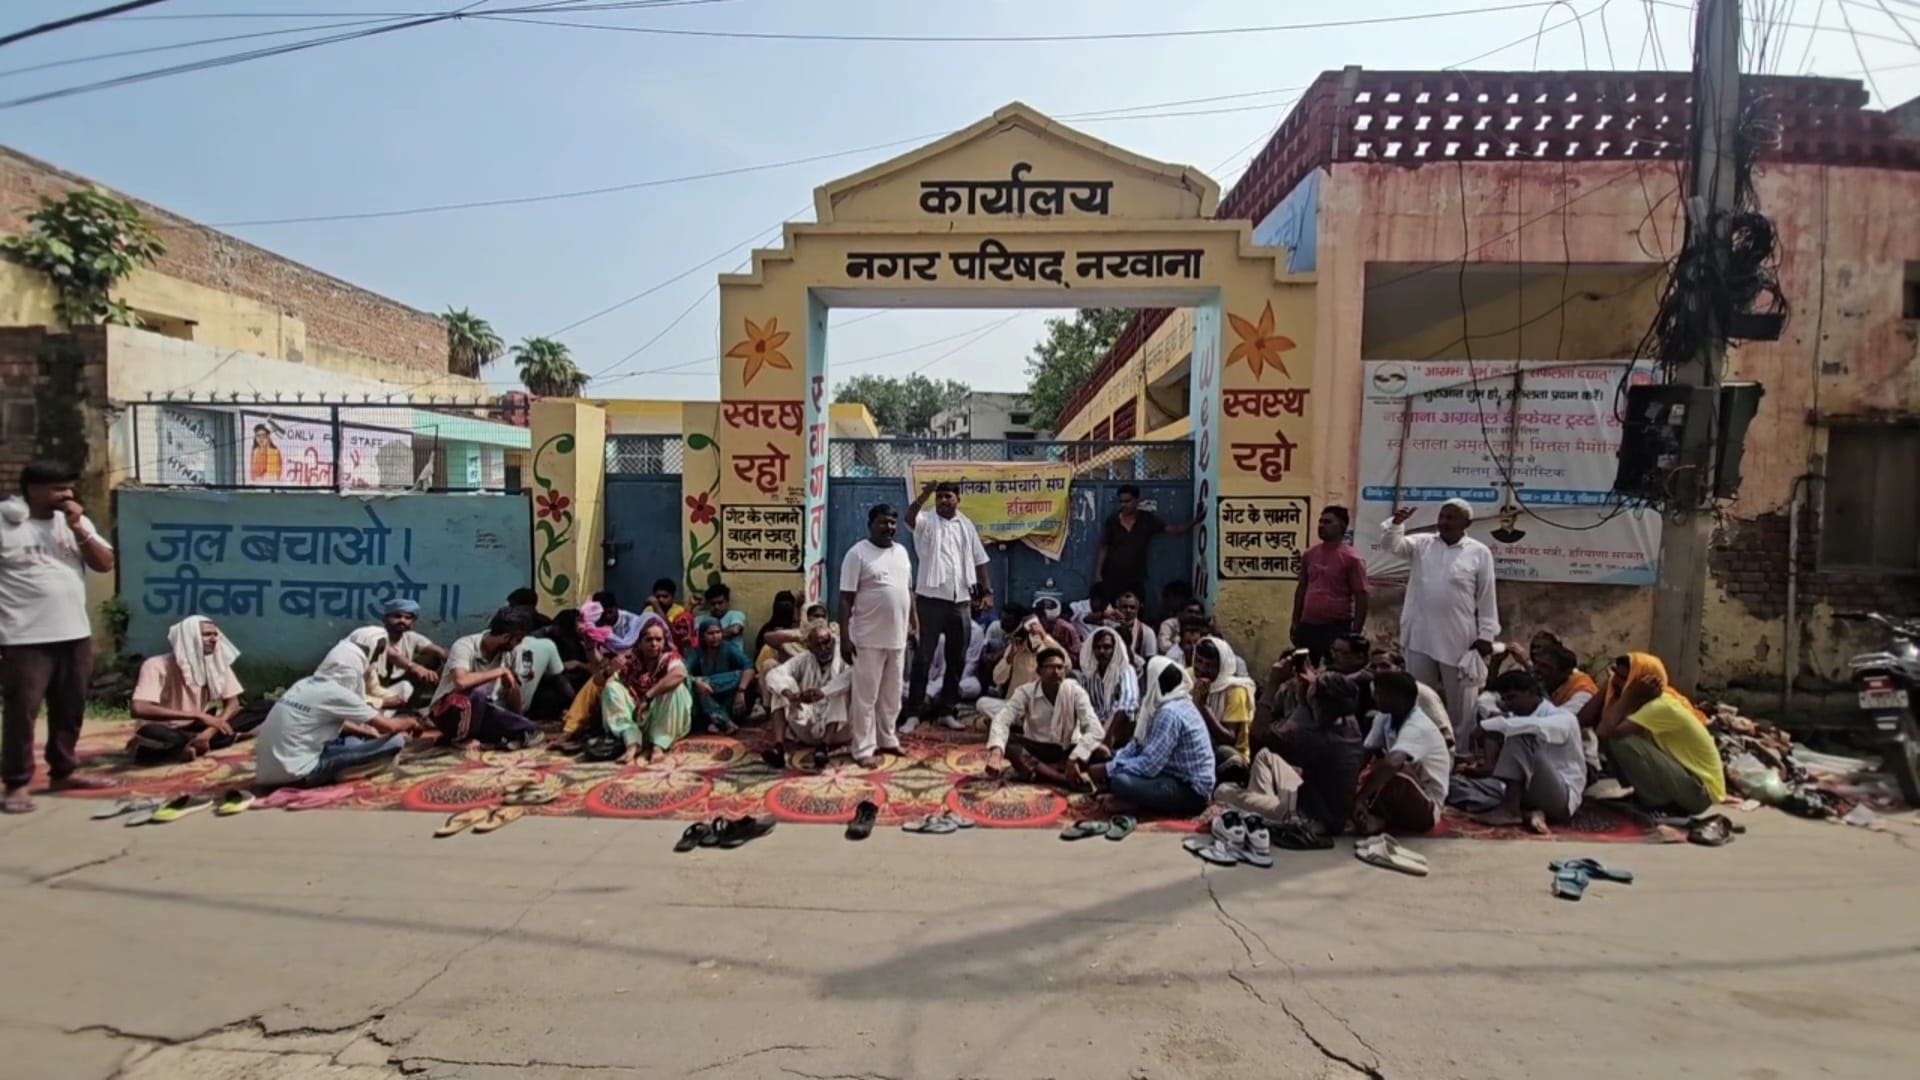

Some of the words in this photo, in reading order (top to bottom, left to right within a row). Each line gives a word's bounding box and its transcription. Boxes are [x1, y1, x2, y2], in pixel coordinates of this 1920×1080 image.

[919, 162, 1113, 215] कार्यालय
[846, 252, 941, 280] नगर
[1076, 249, 1204, 280] नरवाना
[722, 400, 805, 436] स्वच्छ
[1223, 388, 1310, 418] स्वस्थ
[1383, 411, 1436, 425] नराना
[286, 446, 333, 486] महिल
[732, 442, 791, 493] रहो
[1231, 429, 1297, 483] रहो
[725, 507, 745, 524] गेट
[747, 507, 762, 524] के
[763, 508, 800, 526] सामने
[1006, 497, 1053, 517] हरियाणा
[1222, 503, 1245, 524] गेट
[1247, 503, 1260, 524] के
[1263, 502, 1301, 526] सामने
[145, 522, 233, 565] जल
[728, 527, 762, 546] वाहन
[1225, 531, 1262, 550] वाहन
[726, 547, 761, 564] करना
[764, 548, 788, 563] मना
[789, 543, 801, 567] है
[1224, 556, 1260, 575] करना
[1261, 556, 1290, 573] मना
[142, 563, 273, 617] जीवन
